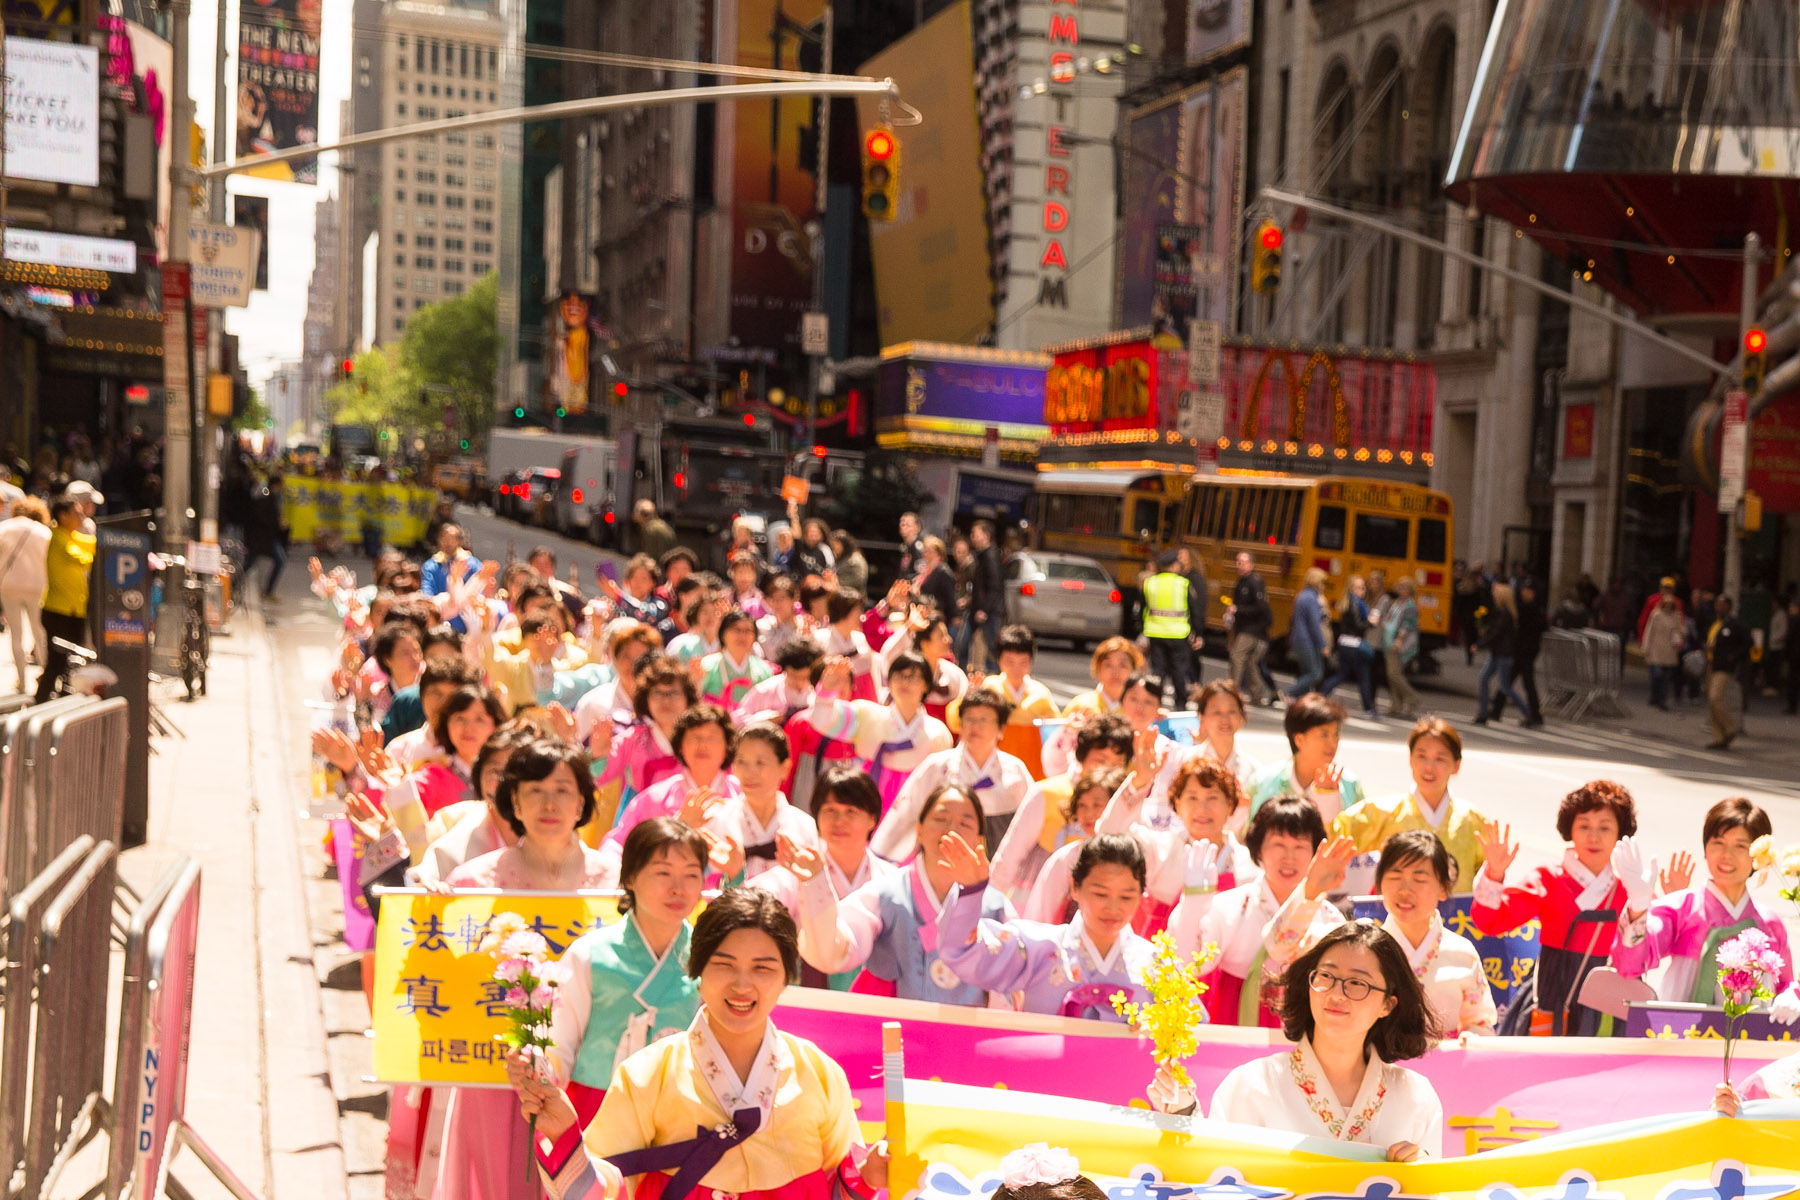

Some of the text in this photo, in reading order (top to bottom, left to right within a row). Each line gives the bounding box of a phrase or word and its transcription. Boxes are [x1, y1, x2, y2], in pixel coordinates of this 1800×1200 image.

[1038, 0, 1080, 310] MSTERDAM
[115, 552, 139, 585] P
[138, 1048, 160, 1151] NYPD
